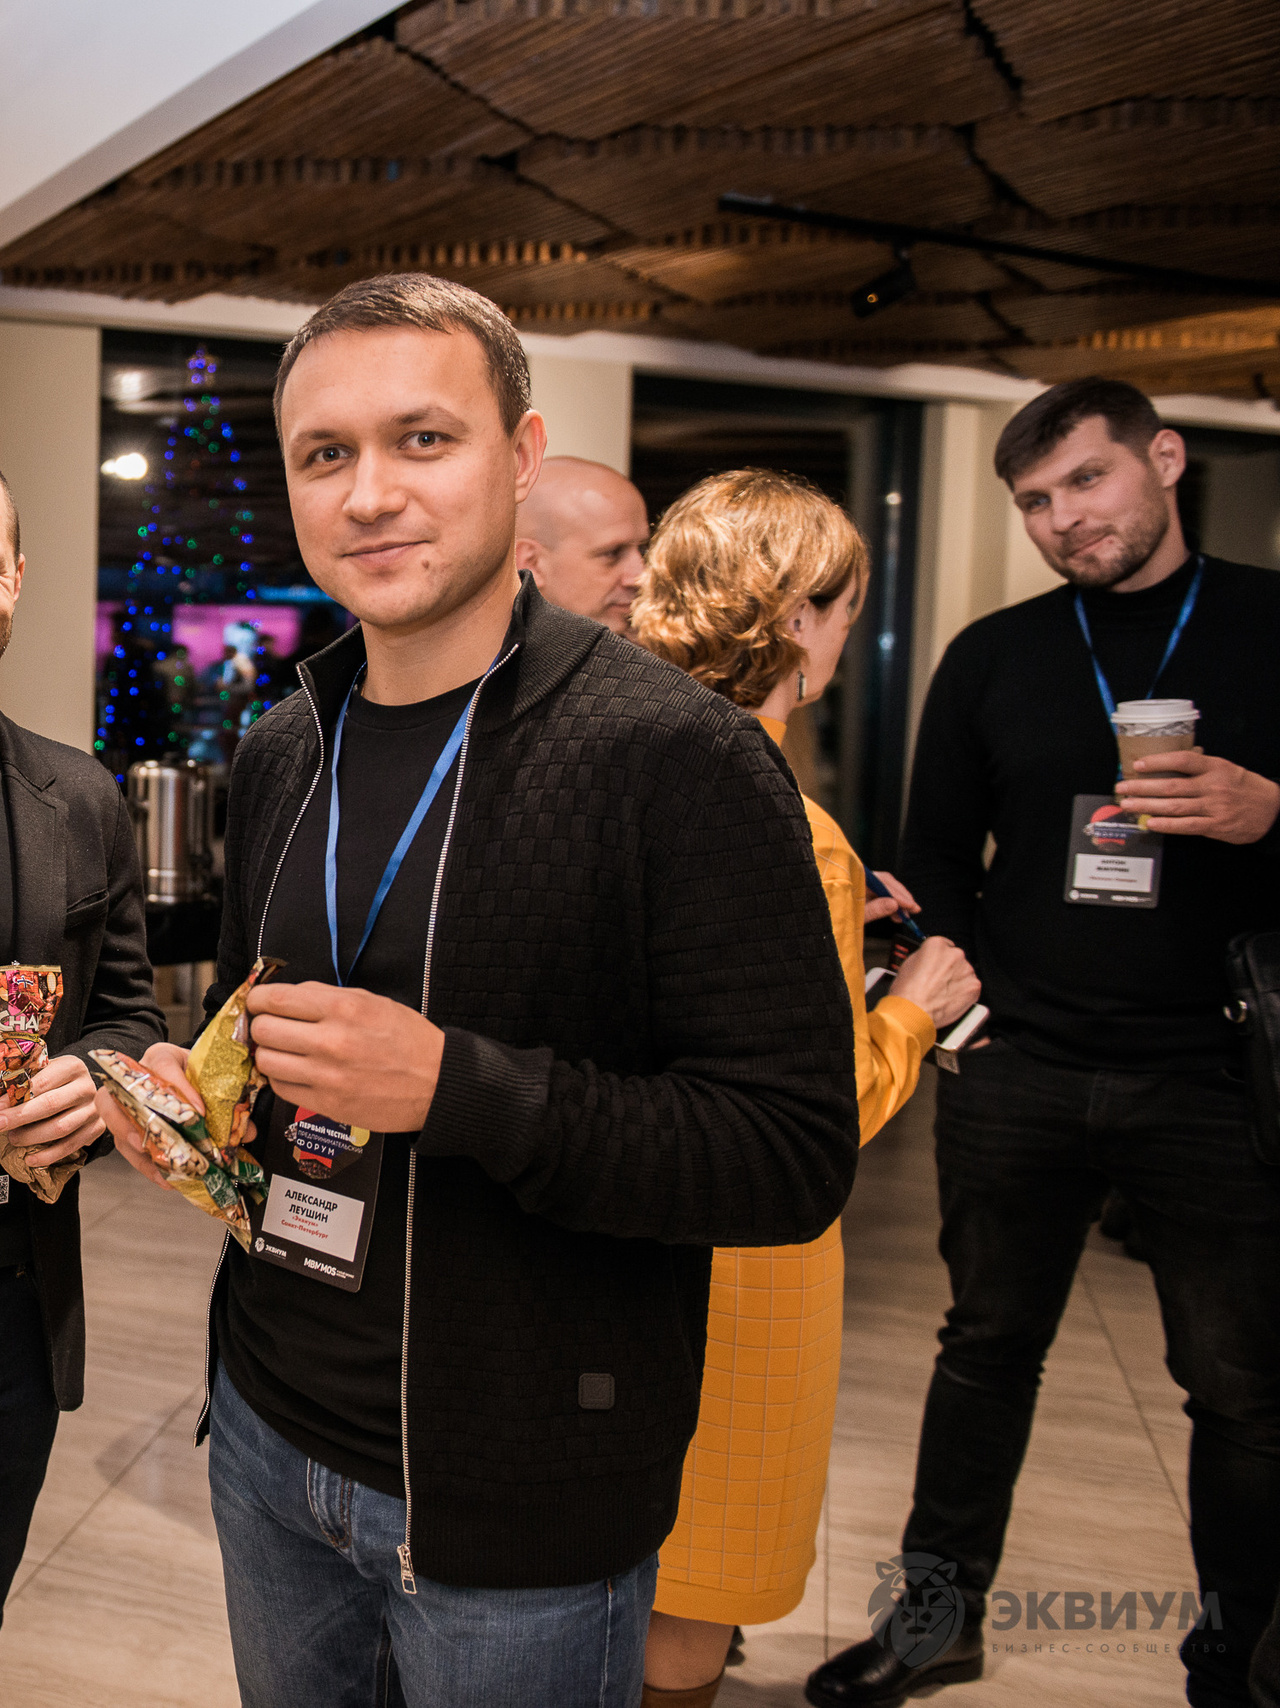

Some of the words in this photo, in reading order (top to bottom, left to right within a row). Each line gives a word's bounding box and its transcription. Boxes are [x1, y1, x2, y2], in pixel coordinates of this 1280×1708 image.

[297, 1129, 364, 1154] ПРЕДПРИНИМАТЕЛЬСКИЙ
[298, 1120, 326, 1135] ПЕРВЫЙ
[326, 1128, 357, 1143] ЧЕСТНЫЙ
[296, 1138, 335, 1156] ФОРУМ
[284, 1189, 338, 1212] АЛЕКСАНДР
[288, 1203, 329, 1223] ЛЕУШИН
[281, 1219, 329, 1240] Санкт-Петербург
[265, 1244, 287, 1258] ЭКВИУМ
